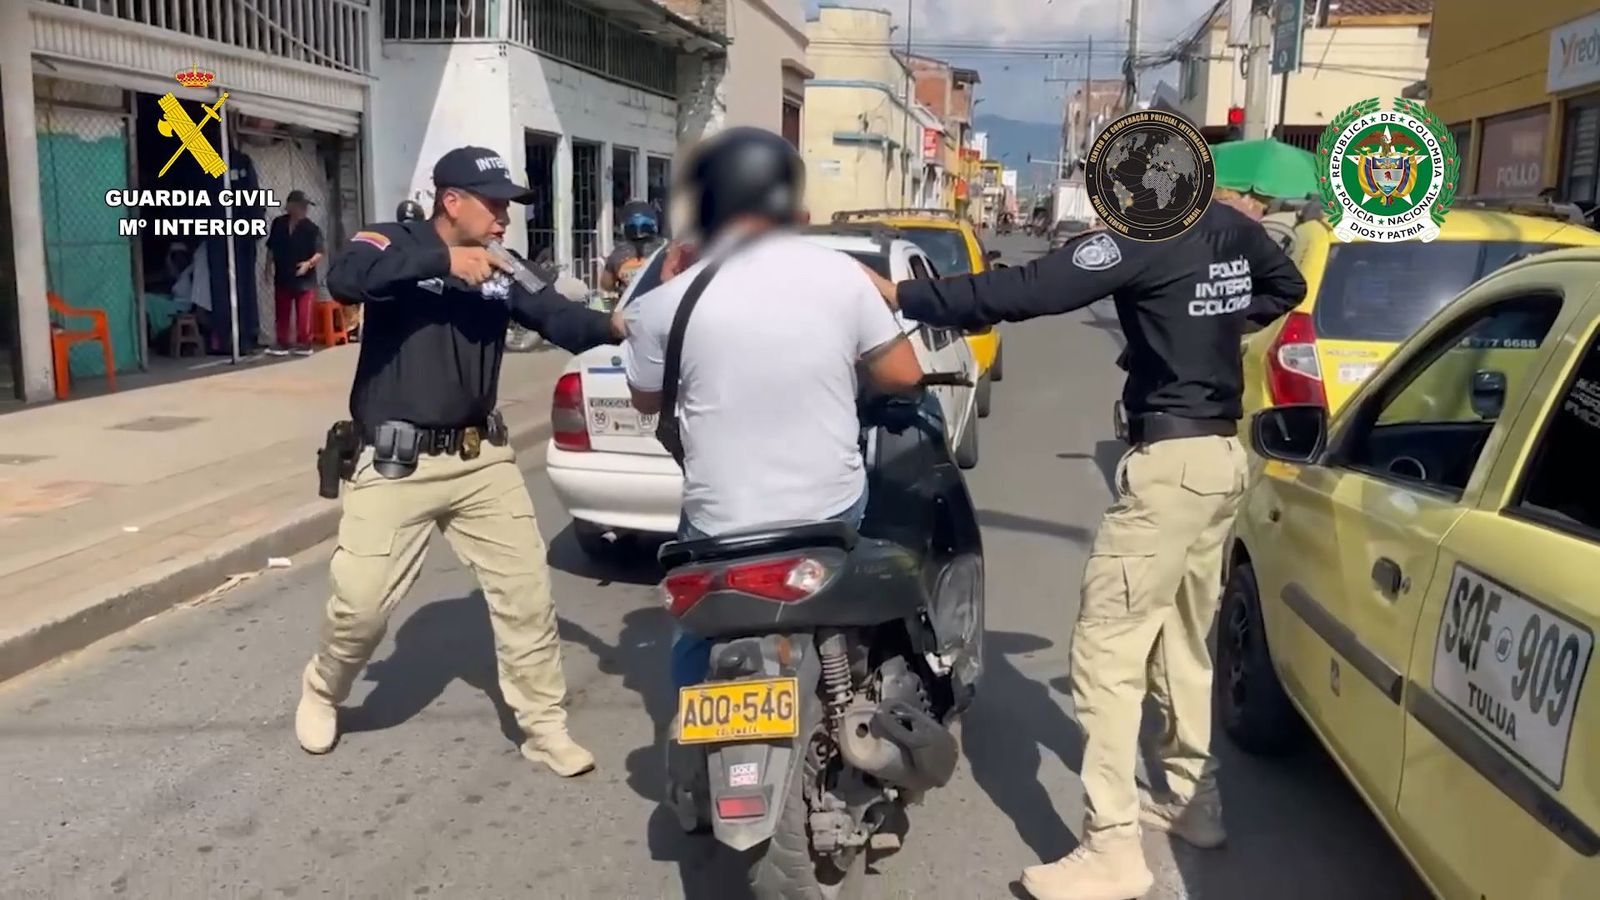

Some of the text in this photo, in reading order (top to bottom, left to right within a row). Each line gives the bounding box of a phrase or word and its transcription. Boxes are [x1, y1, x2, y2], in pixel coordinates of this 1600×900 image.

[1445, 577, 1580, 727] SQF 909
[742, 689, 793, 723] 54G
[1467, 681, 1517, 742] TULUA
